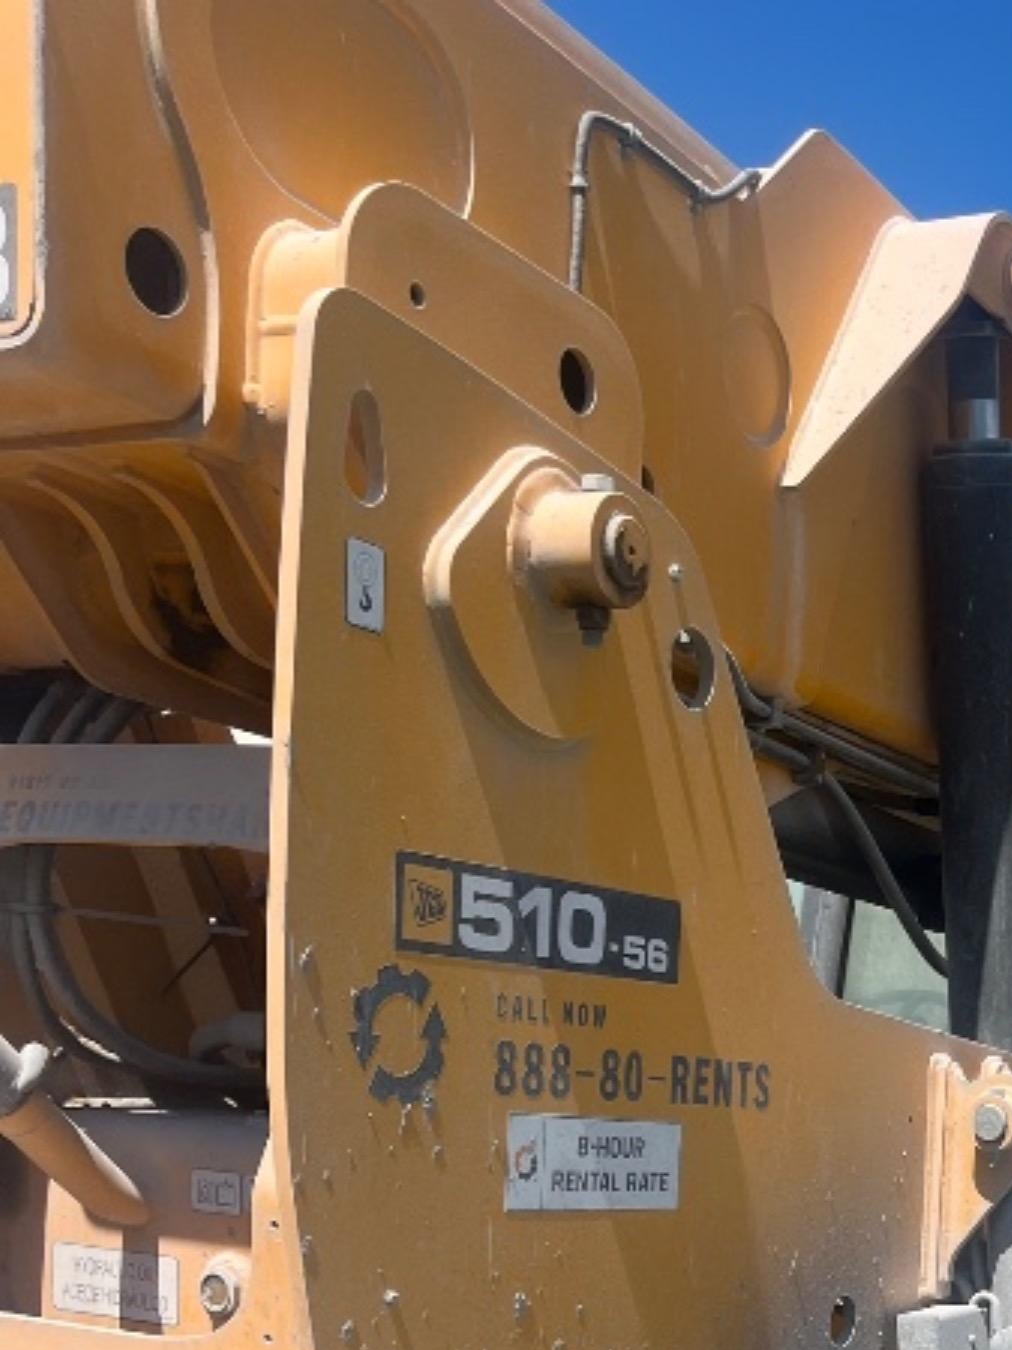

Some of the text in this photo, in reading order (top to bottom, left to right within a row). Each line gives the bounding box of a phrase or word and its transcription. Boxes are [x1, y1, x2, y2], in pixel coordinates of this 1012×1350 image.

[496, 993, 607, 1029] CALL NOW
[494, 1040, 770, 1110] 888-80-RENTS
[577, 1136, 646, 1159] 8-HOUR
[551, 1170, 670, 1193] RENTAL RATE
